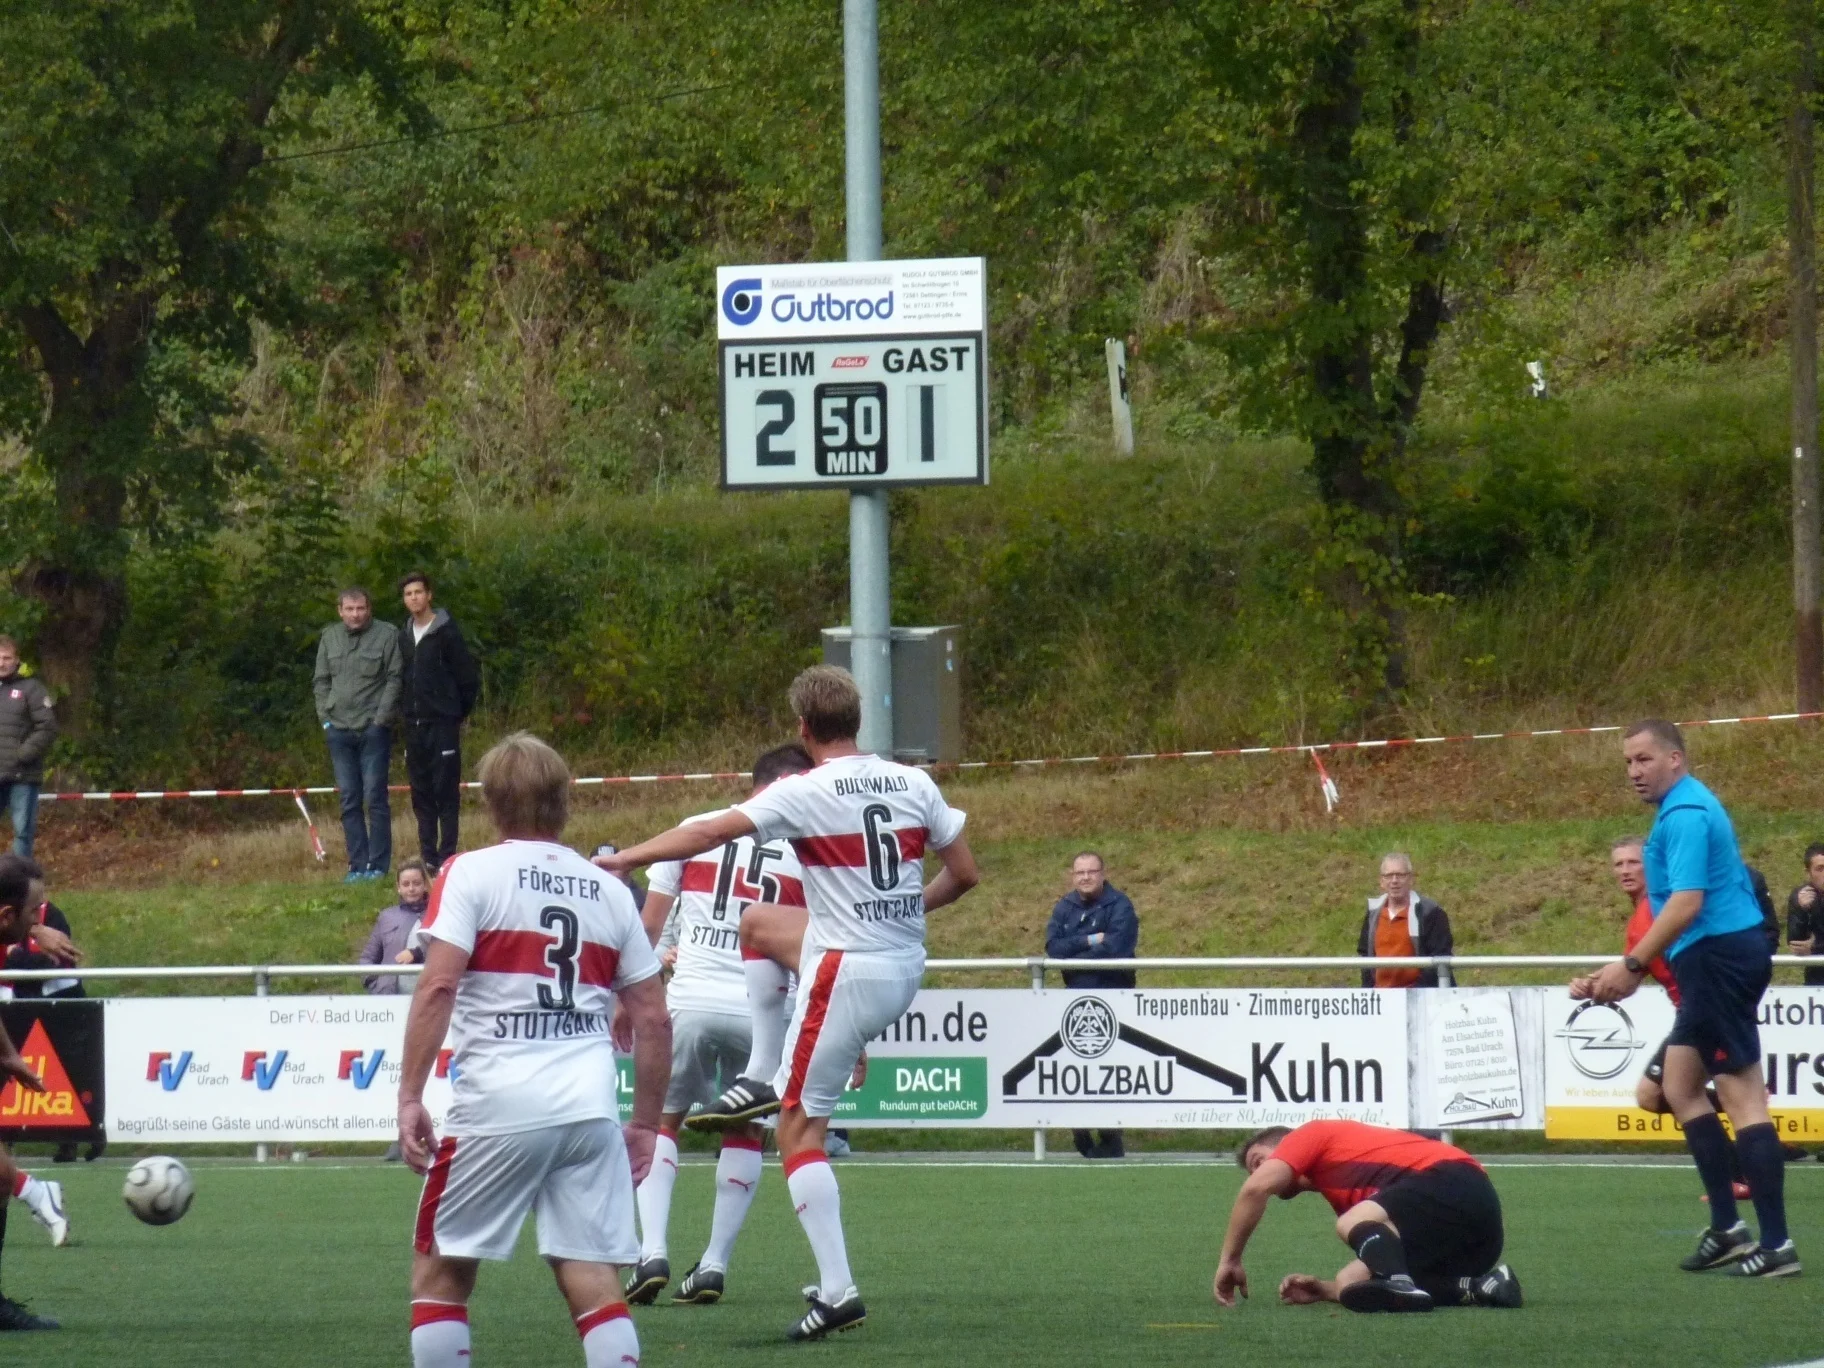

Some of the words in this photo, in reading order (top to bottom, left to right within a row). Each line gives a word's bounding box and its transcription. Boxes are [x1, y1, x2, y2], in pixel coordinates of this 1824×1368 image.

[807, 278, 817, 287] für
[771, 290, 893, 322] Gutbrod
[734, 351, 815, 378] HEIM
[882, 346, 970, 373] GAST
[756, 389, 796, 466] 2
[821, 396, 881, 447] 50
[920, 385, 935, 462] 1
[827, 451, 876, 474] MIN
[834, 776, 909, 796] BUCHWALD
[862, 803, 900, 891] 6
[518, 865, 600, 901] FÖRSTER
[713, 842, 783, 918] 15
[536, 905, 579, 1009] 3
[270, 1010, 293, 1024] Der
[298, 1010, 318, 1024] FV.
[324, 1010, 350, 1023] Bad
[355, 1009, 394, 1022] Urach
[1134, 993, 1229, 1020] Treppenbau
[1249, 993, 1383, 1019] Zimmergeschäft
[1445, 1018, 1475, 1030] Holzbau
[1477, 1016, 1497, 1026] Kuhn
[1441, 1034, 1455, 1044] Am
[1465, 1045, 1480, 1055] Bad
[1482, 1041, 1504, 1053] Urach
[189, 1062, 209, 1073] Bad
[284, 1061, 305, 1072] Bad
[1252, 1042, 1384, 1104] Kuhn
[1444, 1061, 1463, 1070] Büro:
[198, 1074, 229, 1085] Urach
[293, 1073, 325, 1084] Urach
[896, 1068, 960, 1092] DACH
[1437, 1067, 1518, 1085] info@holzbaukuhn.de
[880, 1101, 918, 1112] Rundum
[920, 1102, 935, 1113] gut
[937, 1101, 978, 1112] beDACHt
[1490, 1095, 1519, 1110] Kuhn
[117, 1116, 168, 1134] begrüßt
[172, 1116, 207, 1131] seine
[212, 1116, 250, 1131] Gäste
[255, 1116, 280, 1130] und
[284, 1116, 339, 1130] wünscht
[343, 1115, 375, 1129] allen
[1173, 1110, 1197, 1124] seit
[1201, 1108, 1233, 1124] über
[1237, 1109, 1253, 1124] 80
[1256, 1108, 1306, 1124] Jahren
[1617, 1113, 1663, 1132] Bad
[1772, 1115, 1818, 1133] Tel.
